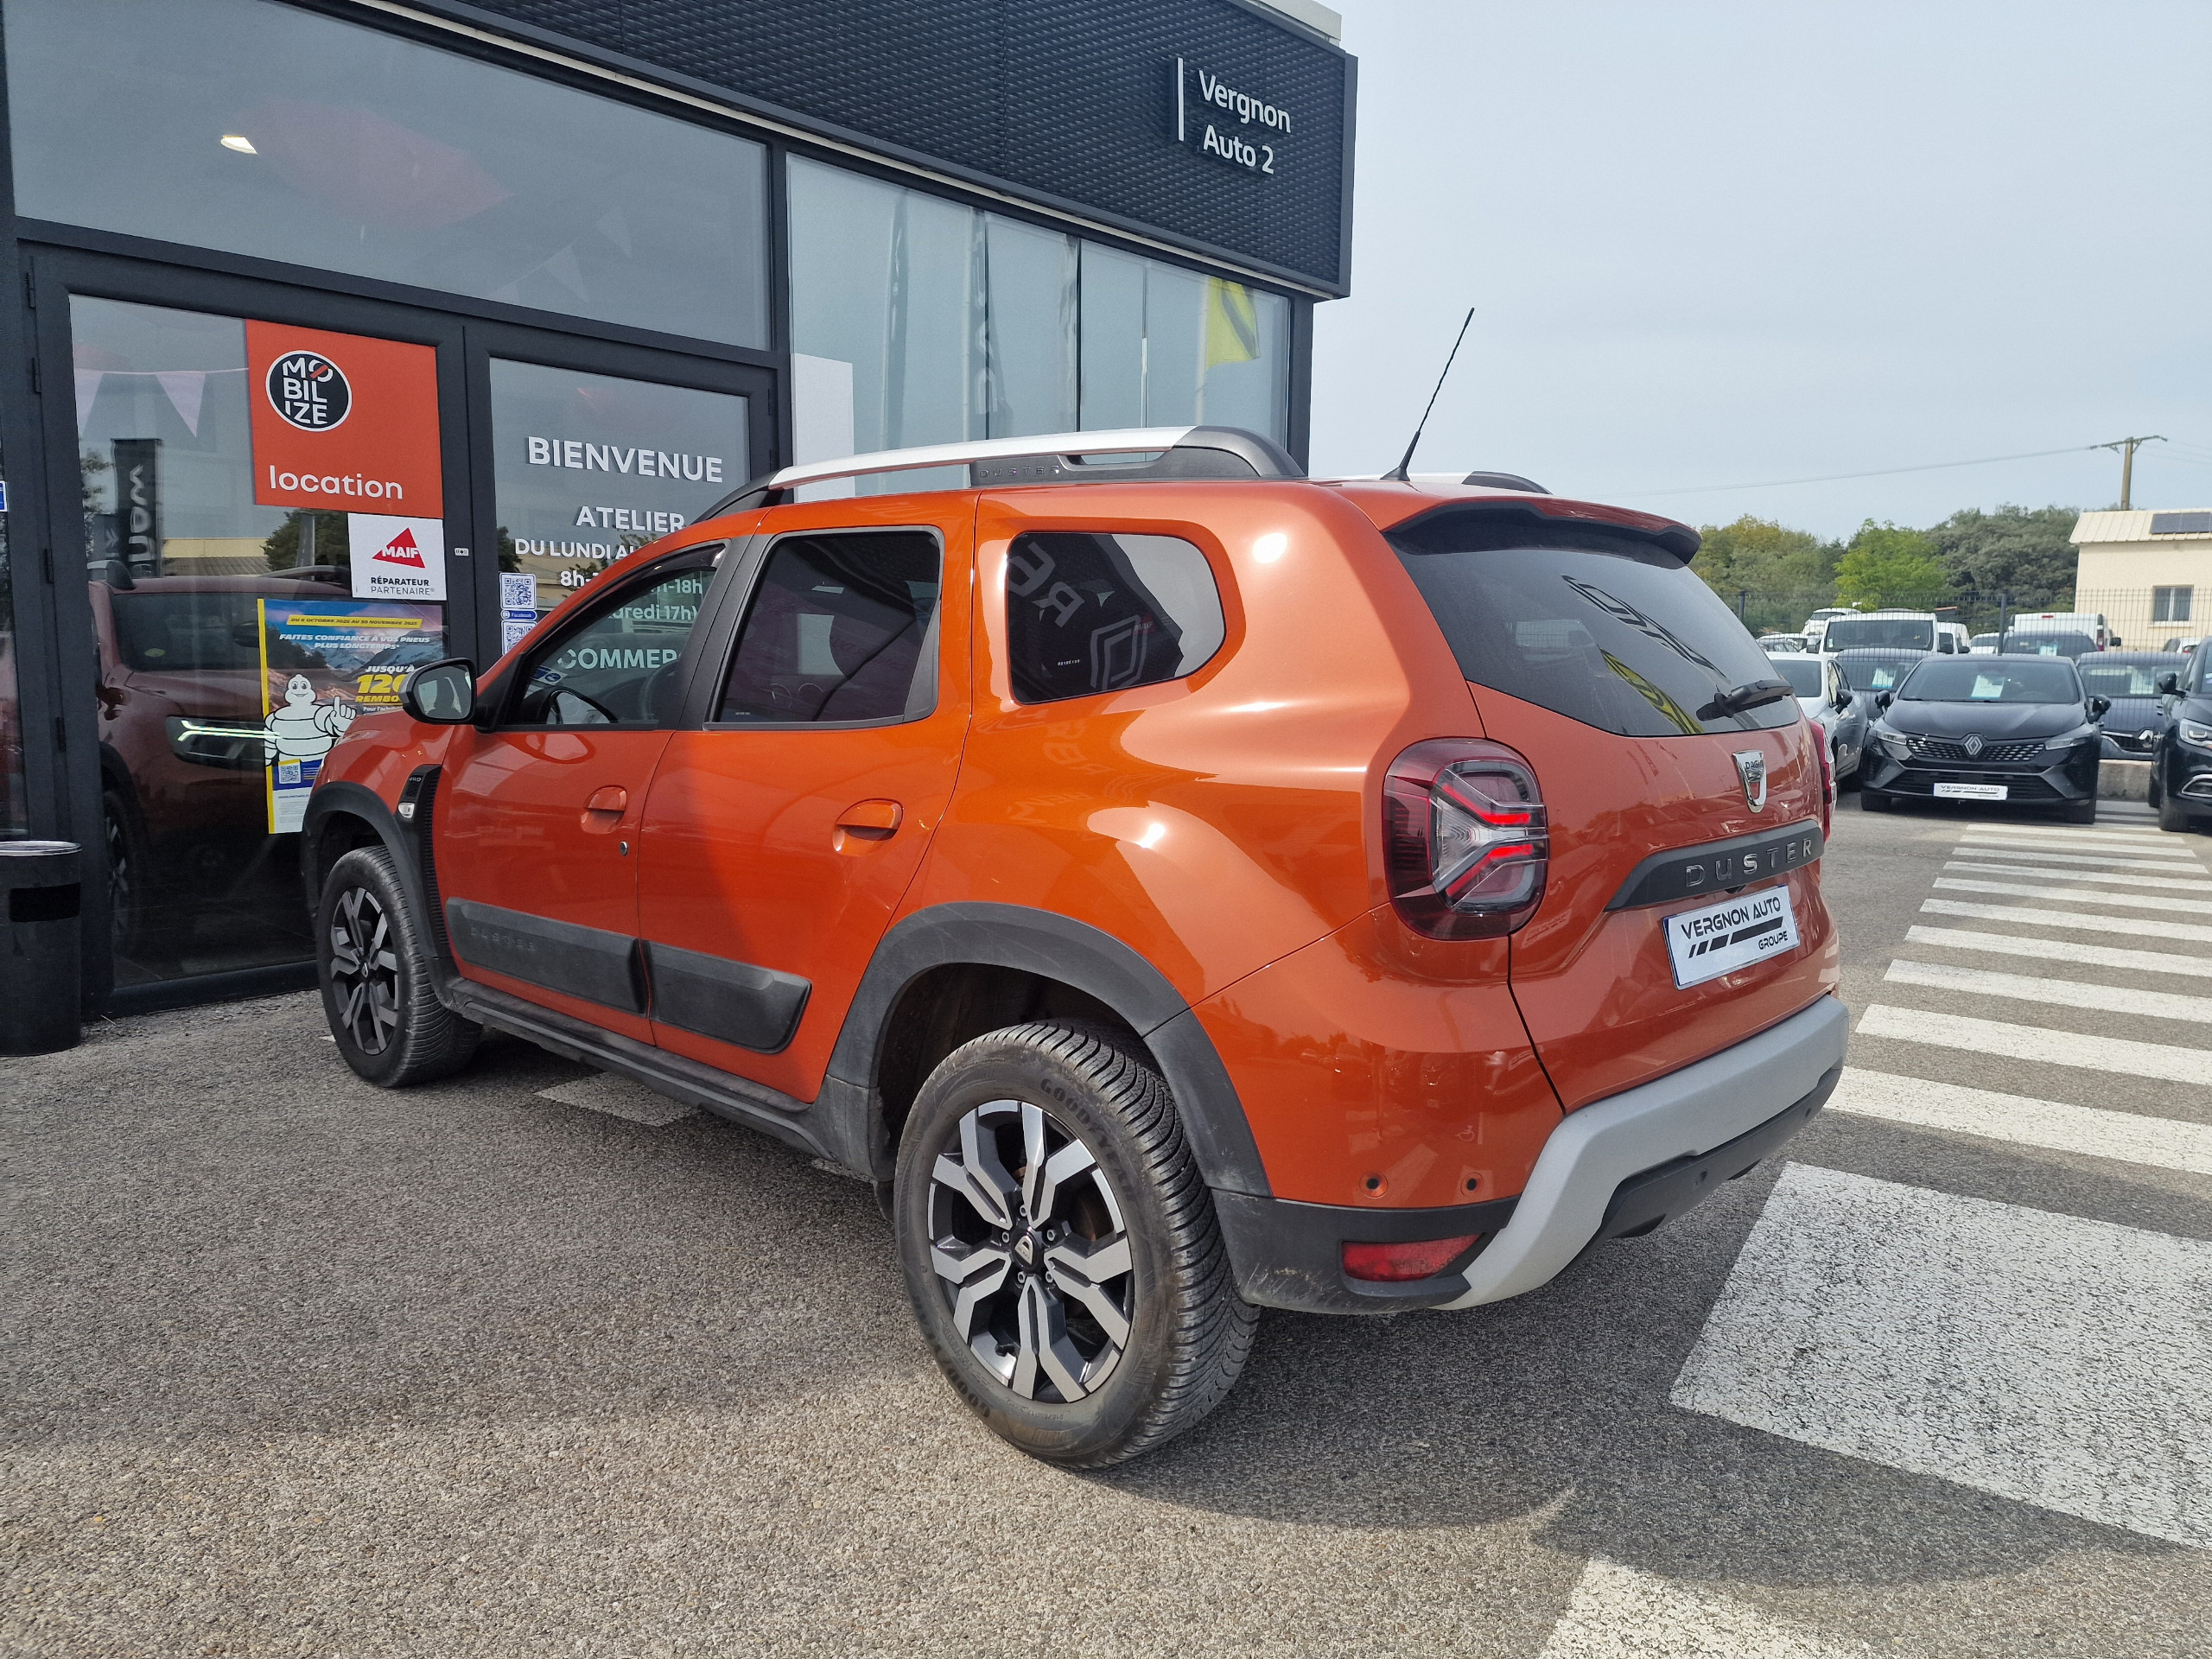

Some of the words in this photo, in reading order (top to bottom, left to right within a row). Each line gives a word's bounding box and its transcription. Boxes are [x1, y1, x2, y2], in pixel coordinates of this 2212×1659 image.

[1198, 69, 1292, 134] Vergnon
[1203, 124, 1257, 167] Auto
[1262, 144, 1274, 175] 2
[526, 435, 723, 484] BIENVENUE
[980, 465, 1060, 478] DUSTER
[270, 465, 404, 499] location
[575, 505, 686, 533] ATELIER
[382, 545, 418, 559] MAIF
[514, 538, 545, 556] DU
[549, 540, 611, 560] LUNDI
[371, 575, 429, 587] RÉPARATEUR
[365, 664, 415, 674] JUSQU'À
[1686, 838, 1811, 887] DUSTER
[1681, 906, 1750, 940] VERGNON
[1752, 896, 1782, 919] AUTO
[1758, 930, 1788, 950] GROUPE
